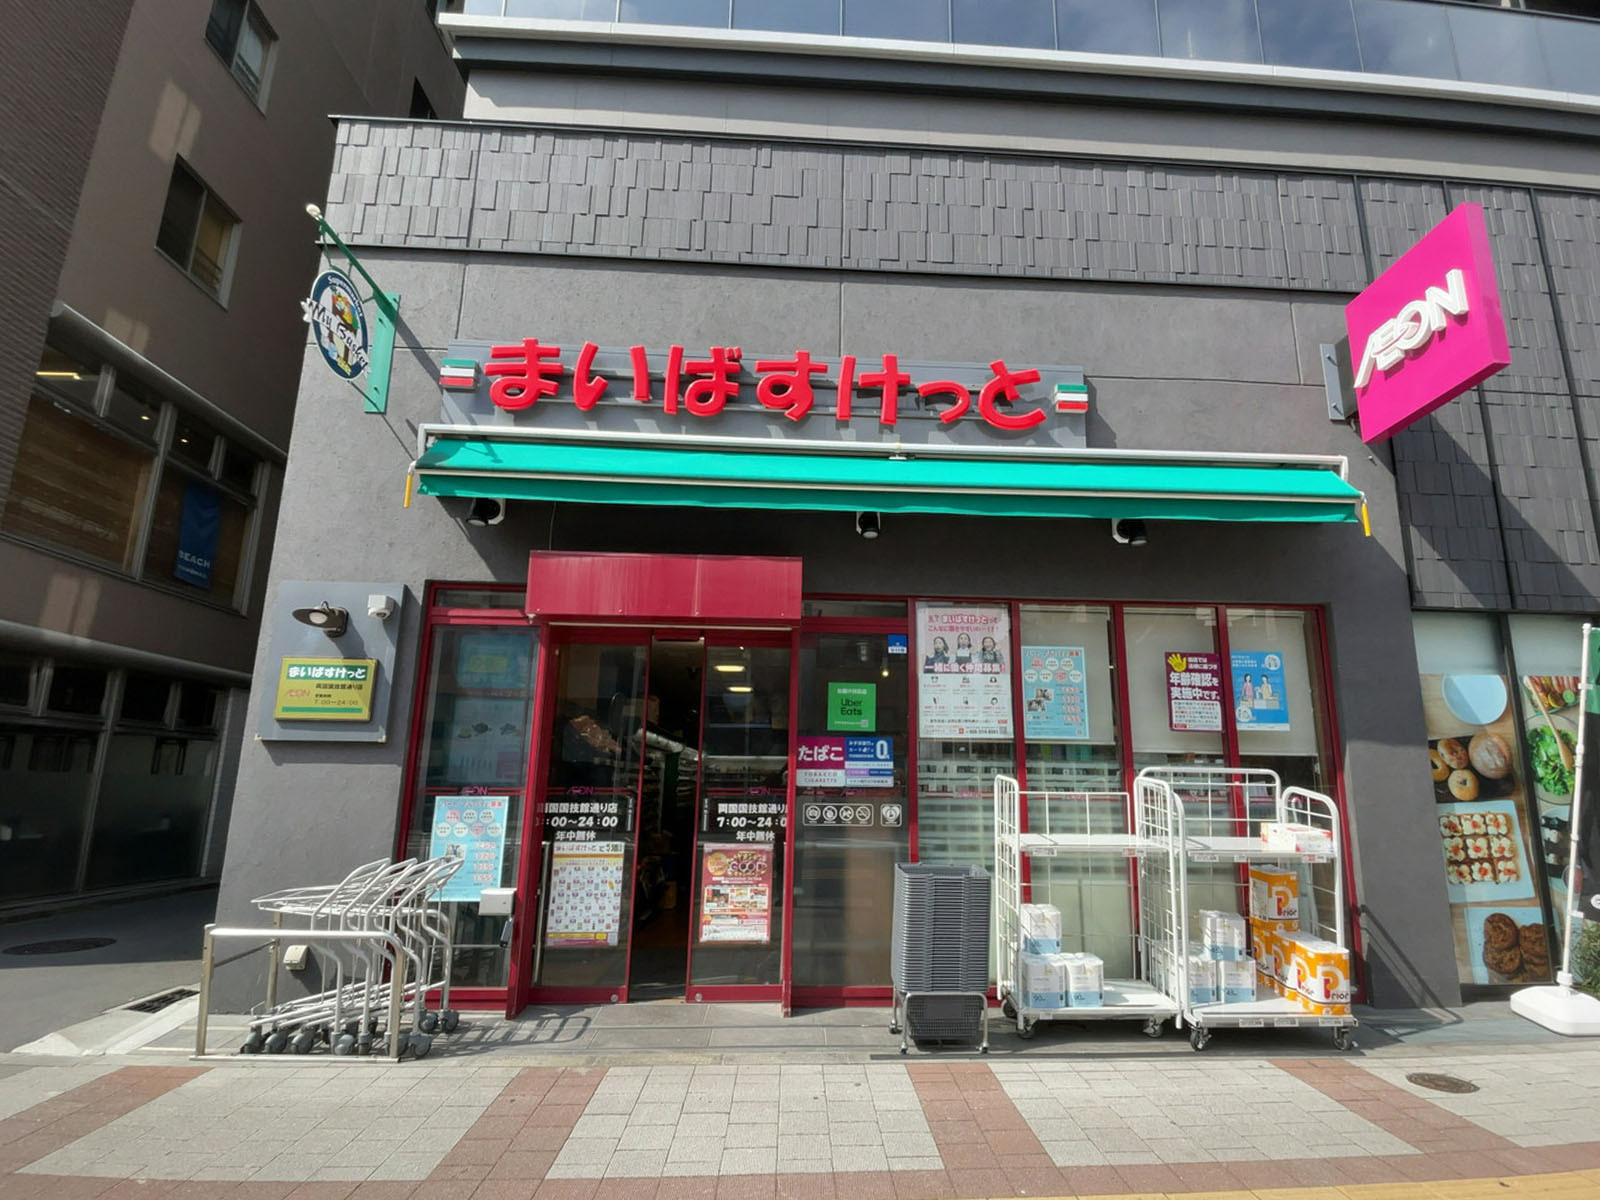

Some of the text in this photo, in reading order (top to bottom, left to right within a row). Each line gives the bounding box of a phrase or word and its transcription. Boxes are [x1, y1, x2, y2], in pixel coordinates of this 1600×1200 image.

[309, 302, 333, 332] My
[485, 337, 1046, 431] まいばすけっと
[178, 550, 211, 568] BEACH
[288, 665, 366, 680] まいばすけっと
[1169, 671, 1219, 687] 年齢確認を
[840, 698, 863, 707] Uber
[840, 707, 863, 716] Eats
[798, 744, 844, 761] たばこ
[717, 803, 788, 814] 両国国技館通り
[545, 816, 618, 827] :00～24:00
[716, 816, 788, 828] 7:00～24:0
[555, 831, 597, 841] 年中無休
[736, 831, 776, 841] 年中無休
[1275, 890, 1298, 917] Prior
[1321, 971, 1350, 1000] Prior
